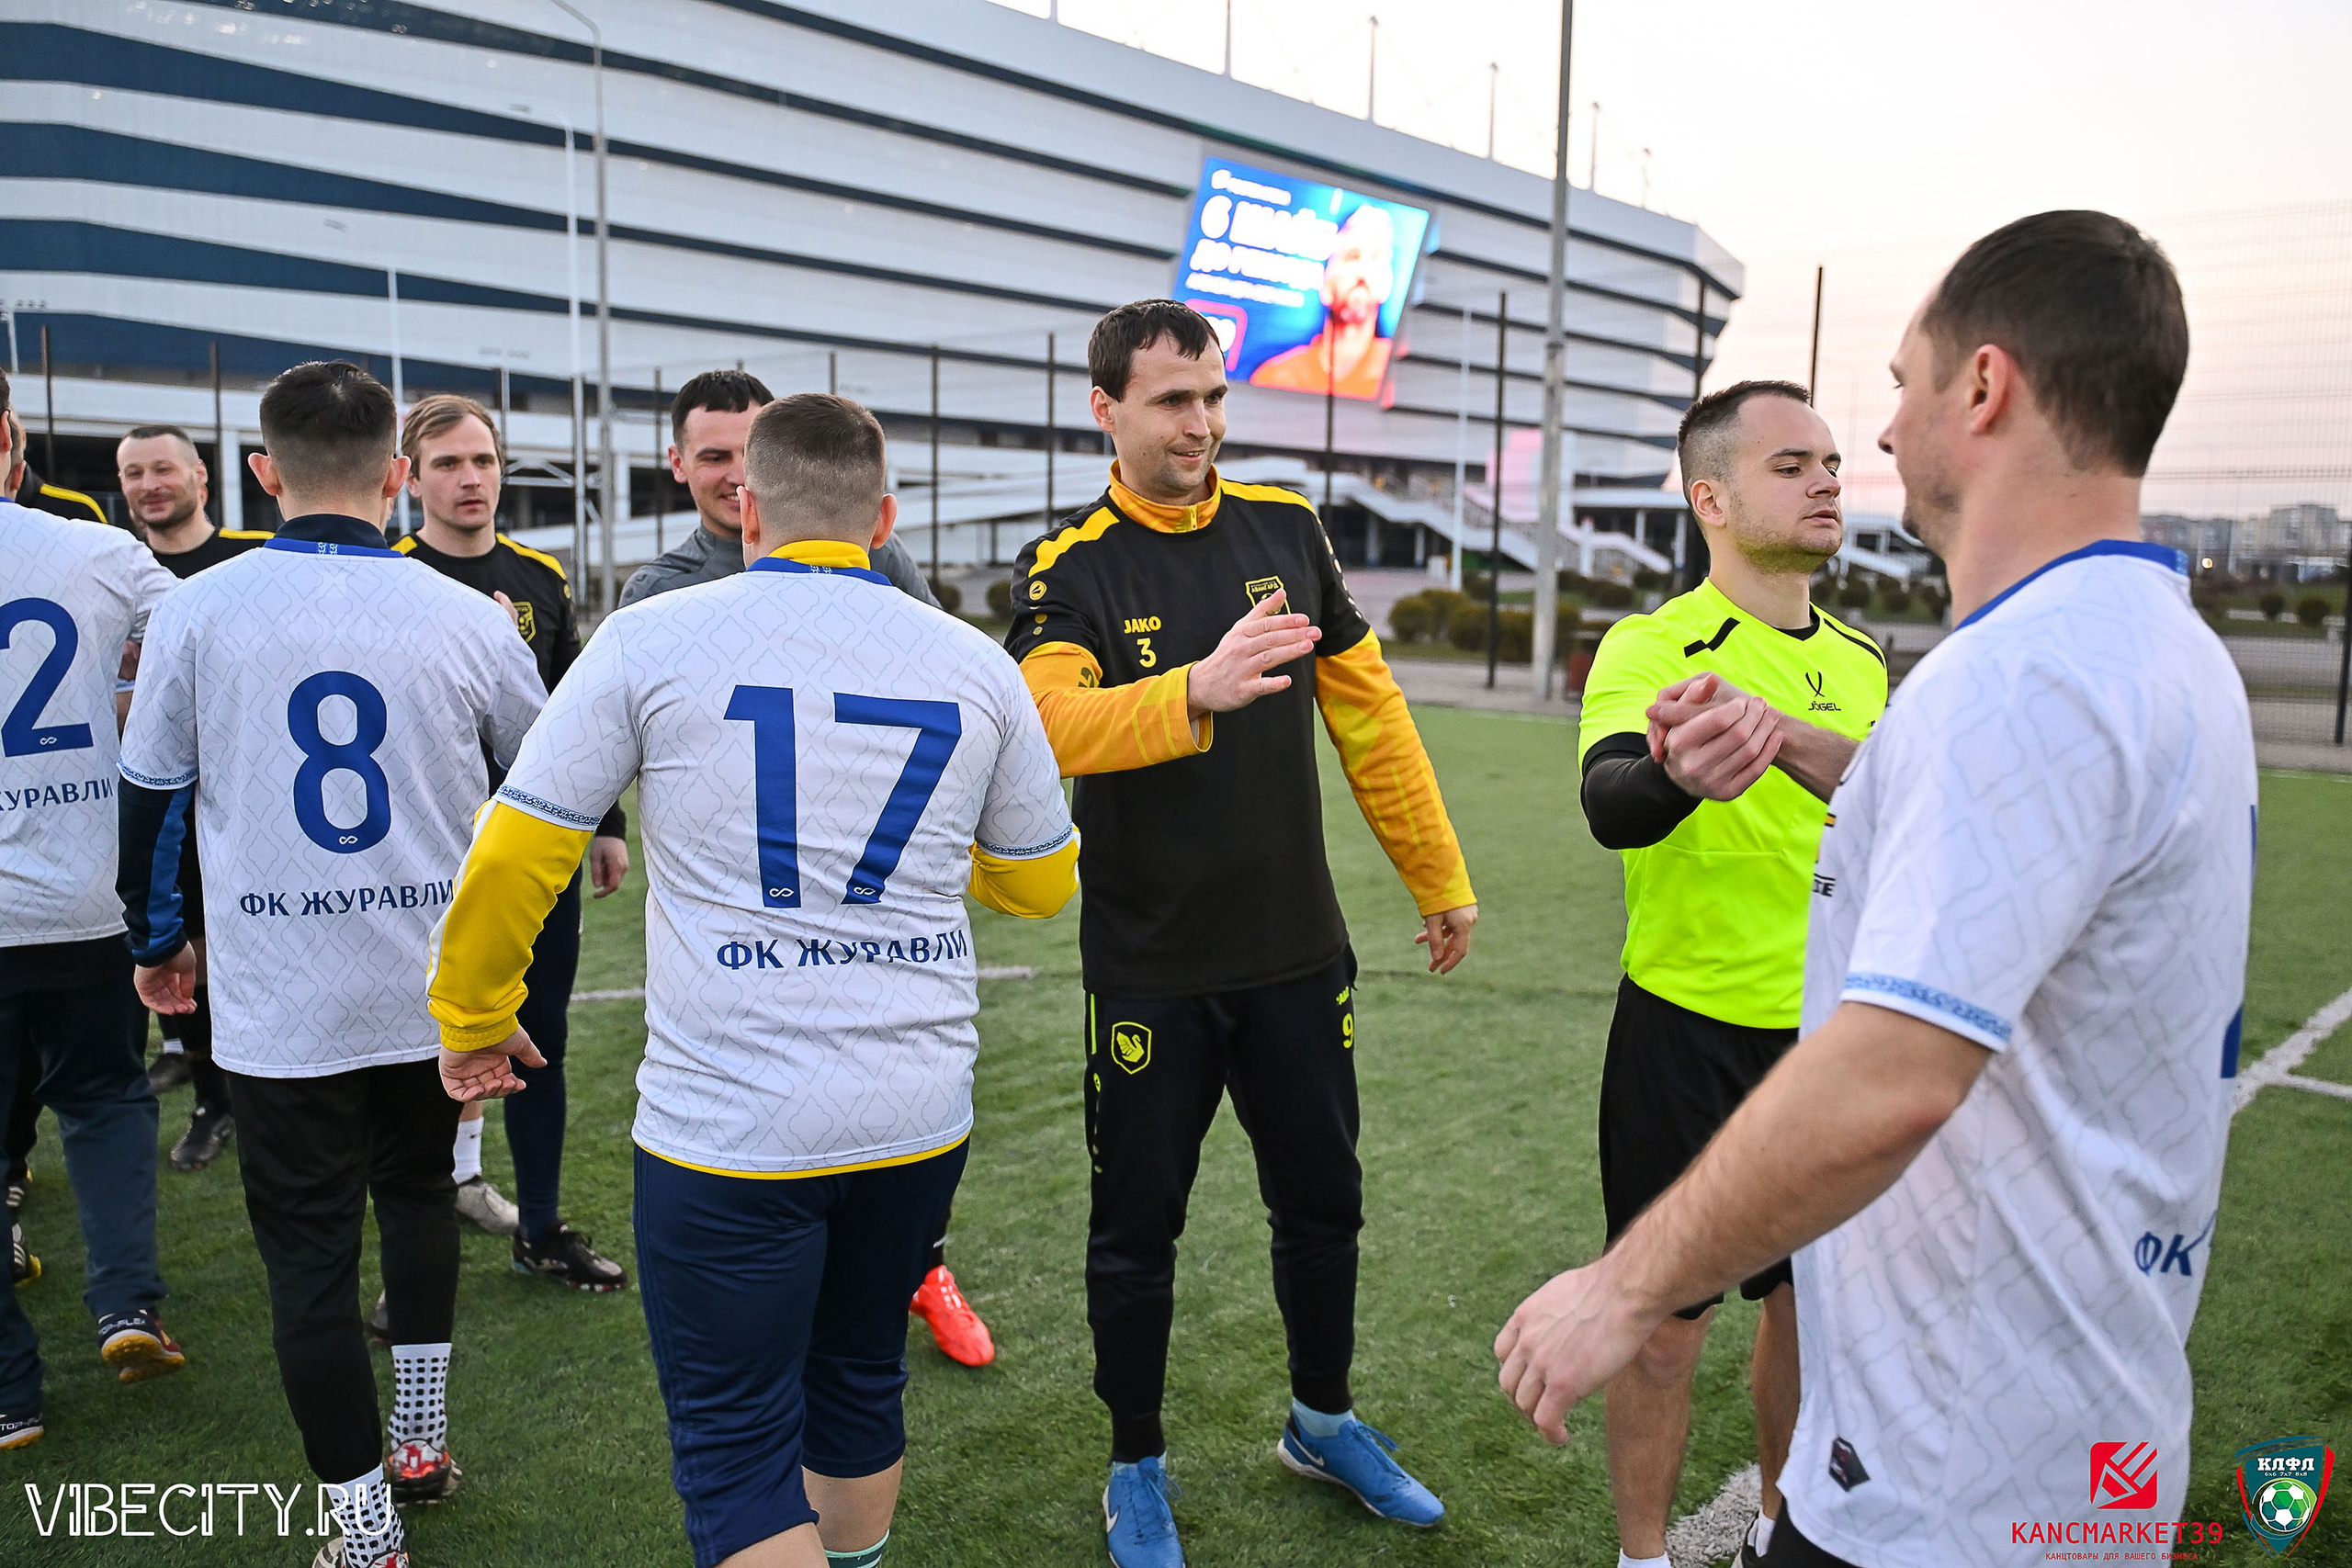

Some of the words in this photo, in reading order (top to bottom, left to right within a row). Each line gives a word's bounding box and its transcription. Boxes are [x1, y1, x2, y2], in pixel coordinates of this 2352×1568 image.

[1124, 615, 1162, 634] JAKO
[1136, 637, 1157, 668] 3
[288, 671, 391, 853] 8
[0, 778, 113, 811] УРАВЛИ
[723, 684, 962, 908] 17
[240, 893, 289, 916] ФК
[300, 879, 454, 916] ЖУРАВЛИ
[717, 941, 784, 970] ФК
[796, 929, 967, 967] ЖУРАВЛИ
[1342, 1012, 1354, 1048] 9
